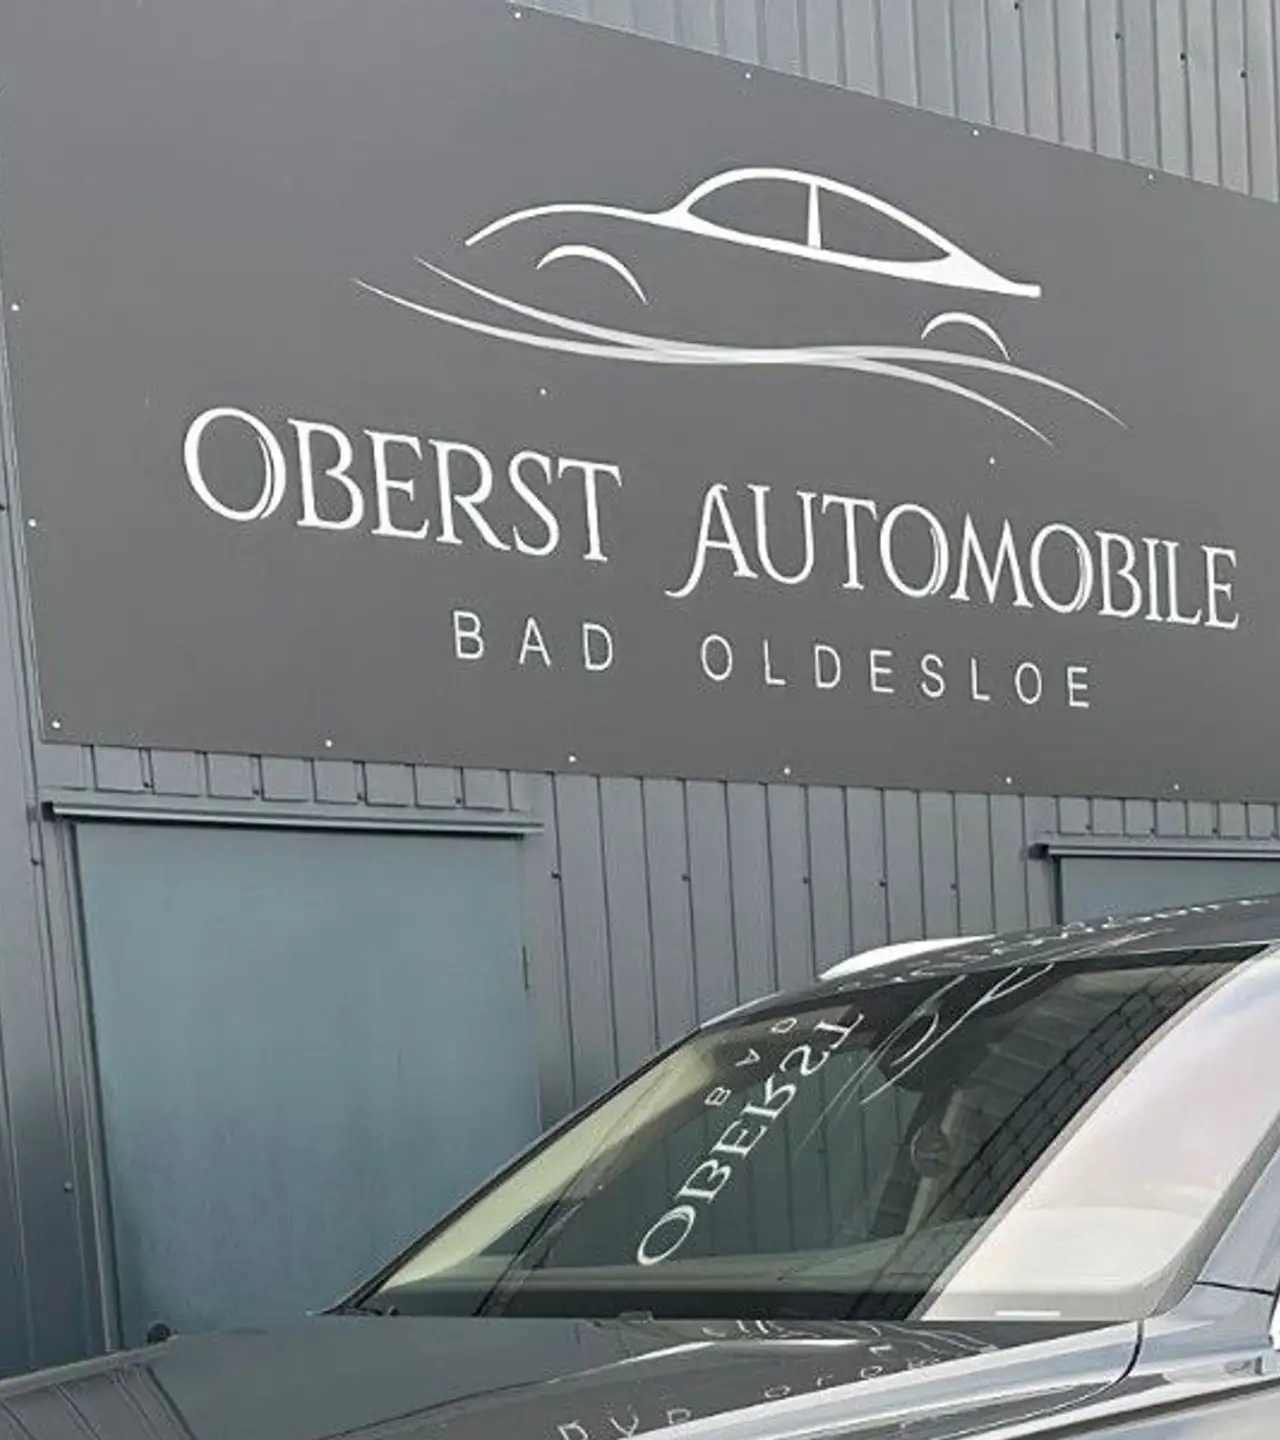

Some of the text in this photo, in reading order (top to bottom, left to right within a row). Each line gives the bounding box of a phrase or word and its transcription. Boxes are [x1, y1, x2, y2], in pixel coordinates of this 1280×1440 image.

[183, 406, 1241, 631] OBERST AUTOMOBILE
[452, 609, 1091, 709] BAD OLDESLOE
